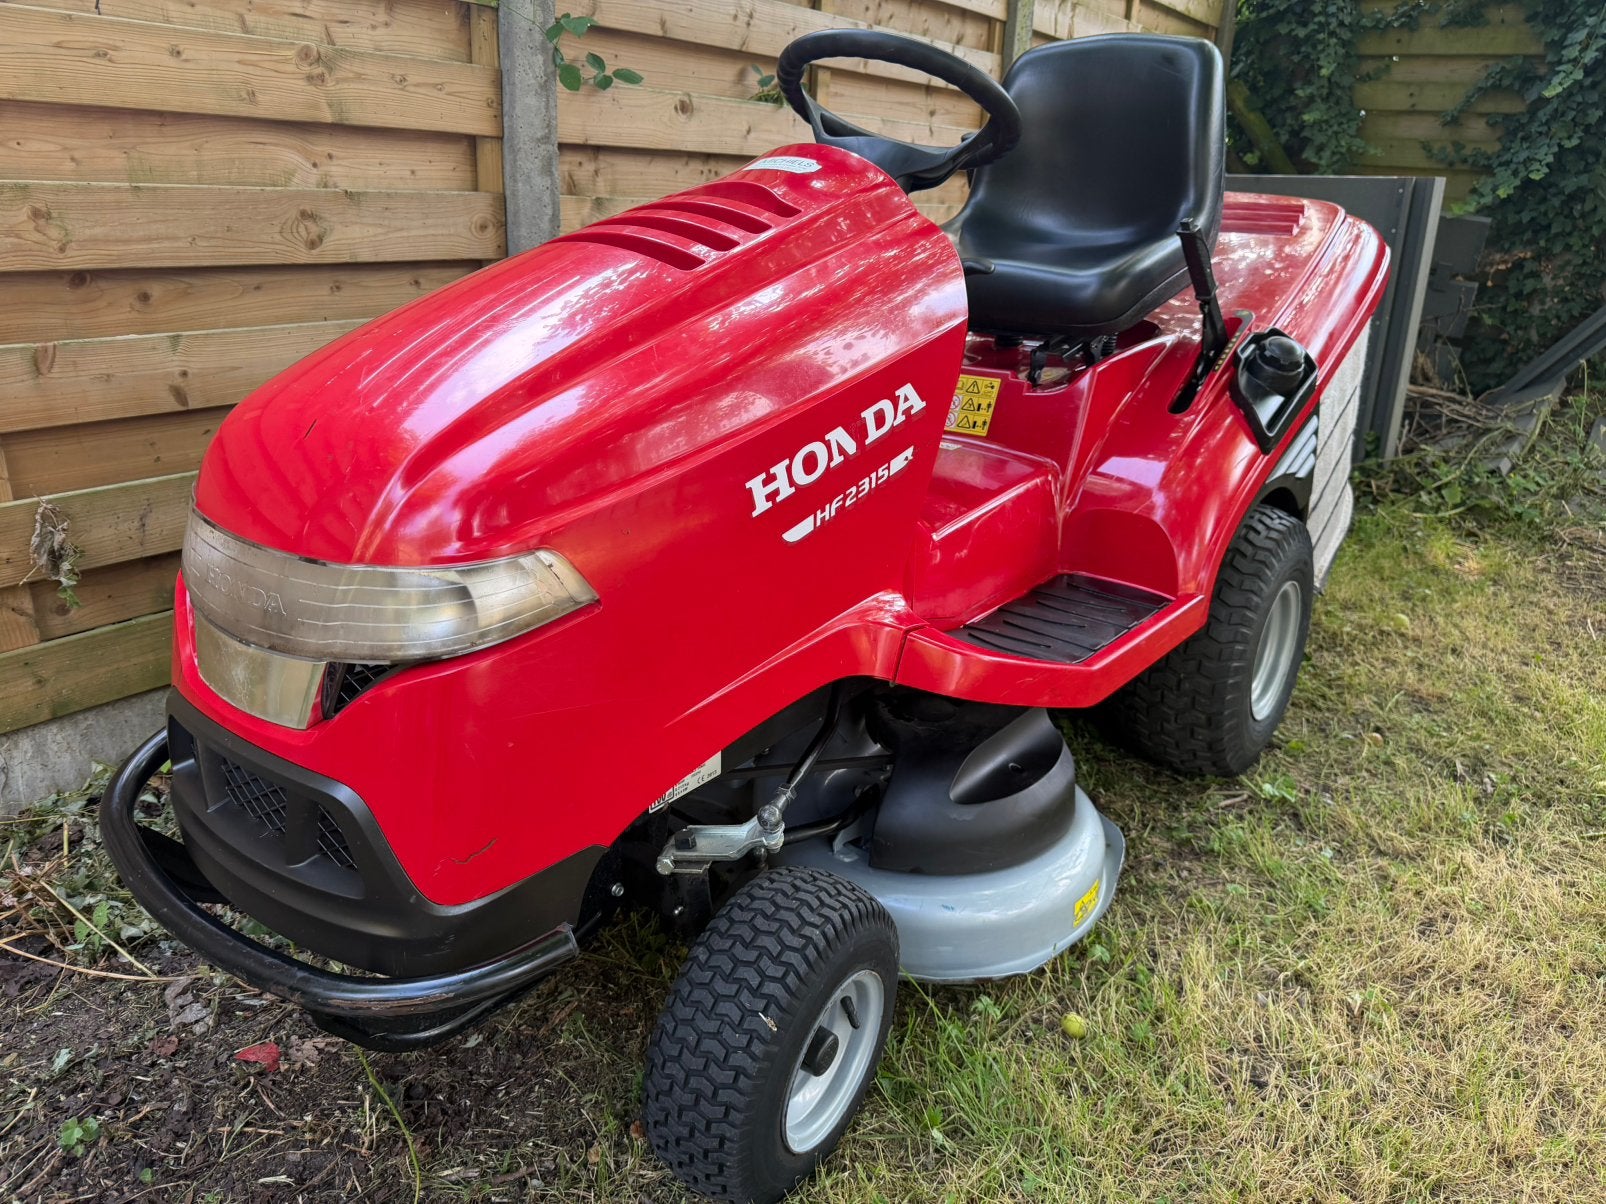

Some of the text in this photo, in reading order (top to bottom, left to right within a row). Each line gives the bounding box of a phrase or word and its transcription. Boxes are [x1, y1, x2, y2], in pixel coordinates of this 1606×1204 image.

[745, 382, 927, 518] HONDA
[816, 463, 888, 528] HF2315
[206, 562, 287, 617] HONDA
